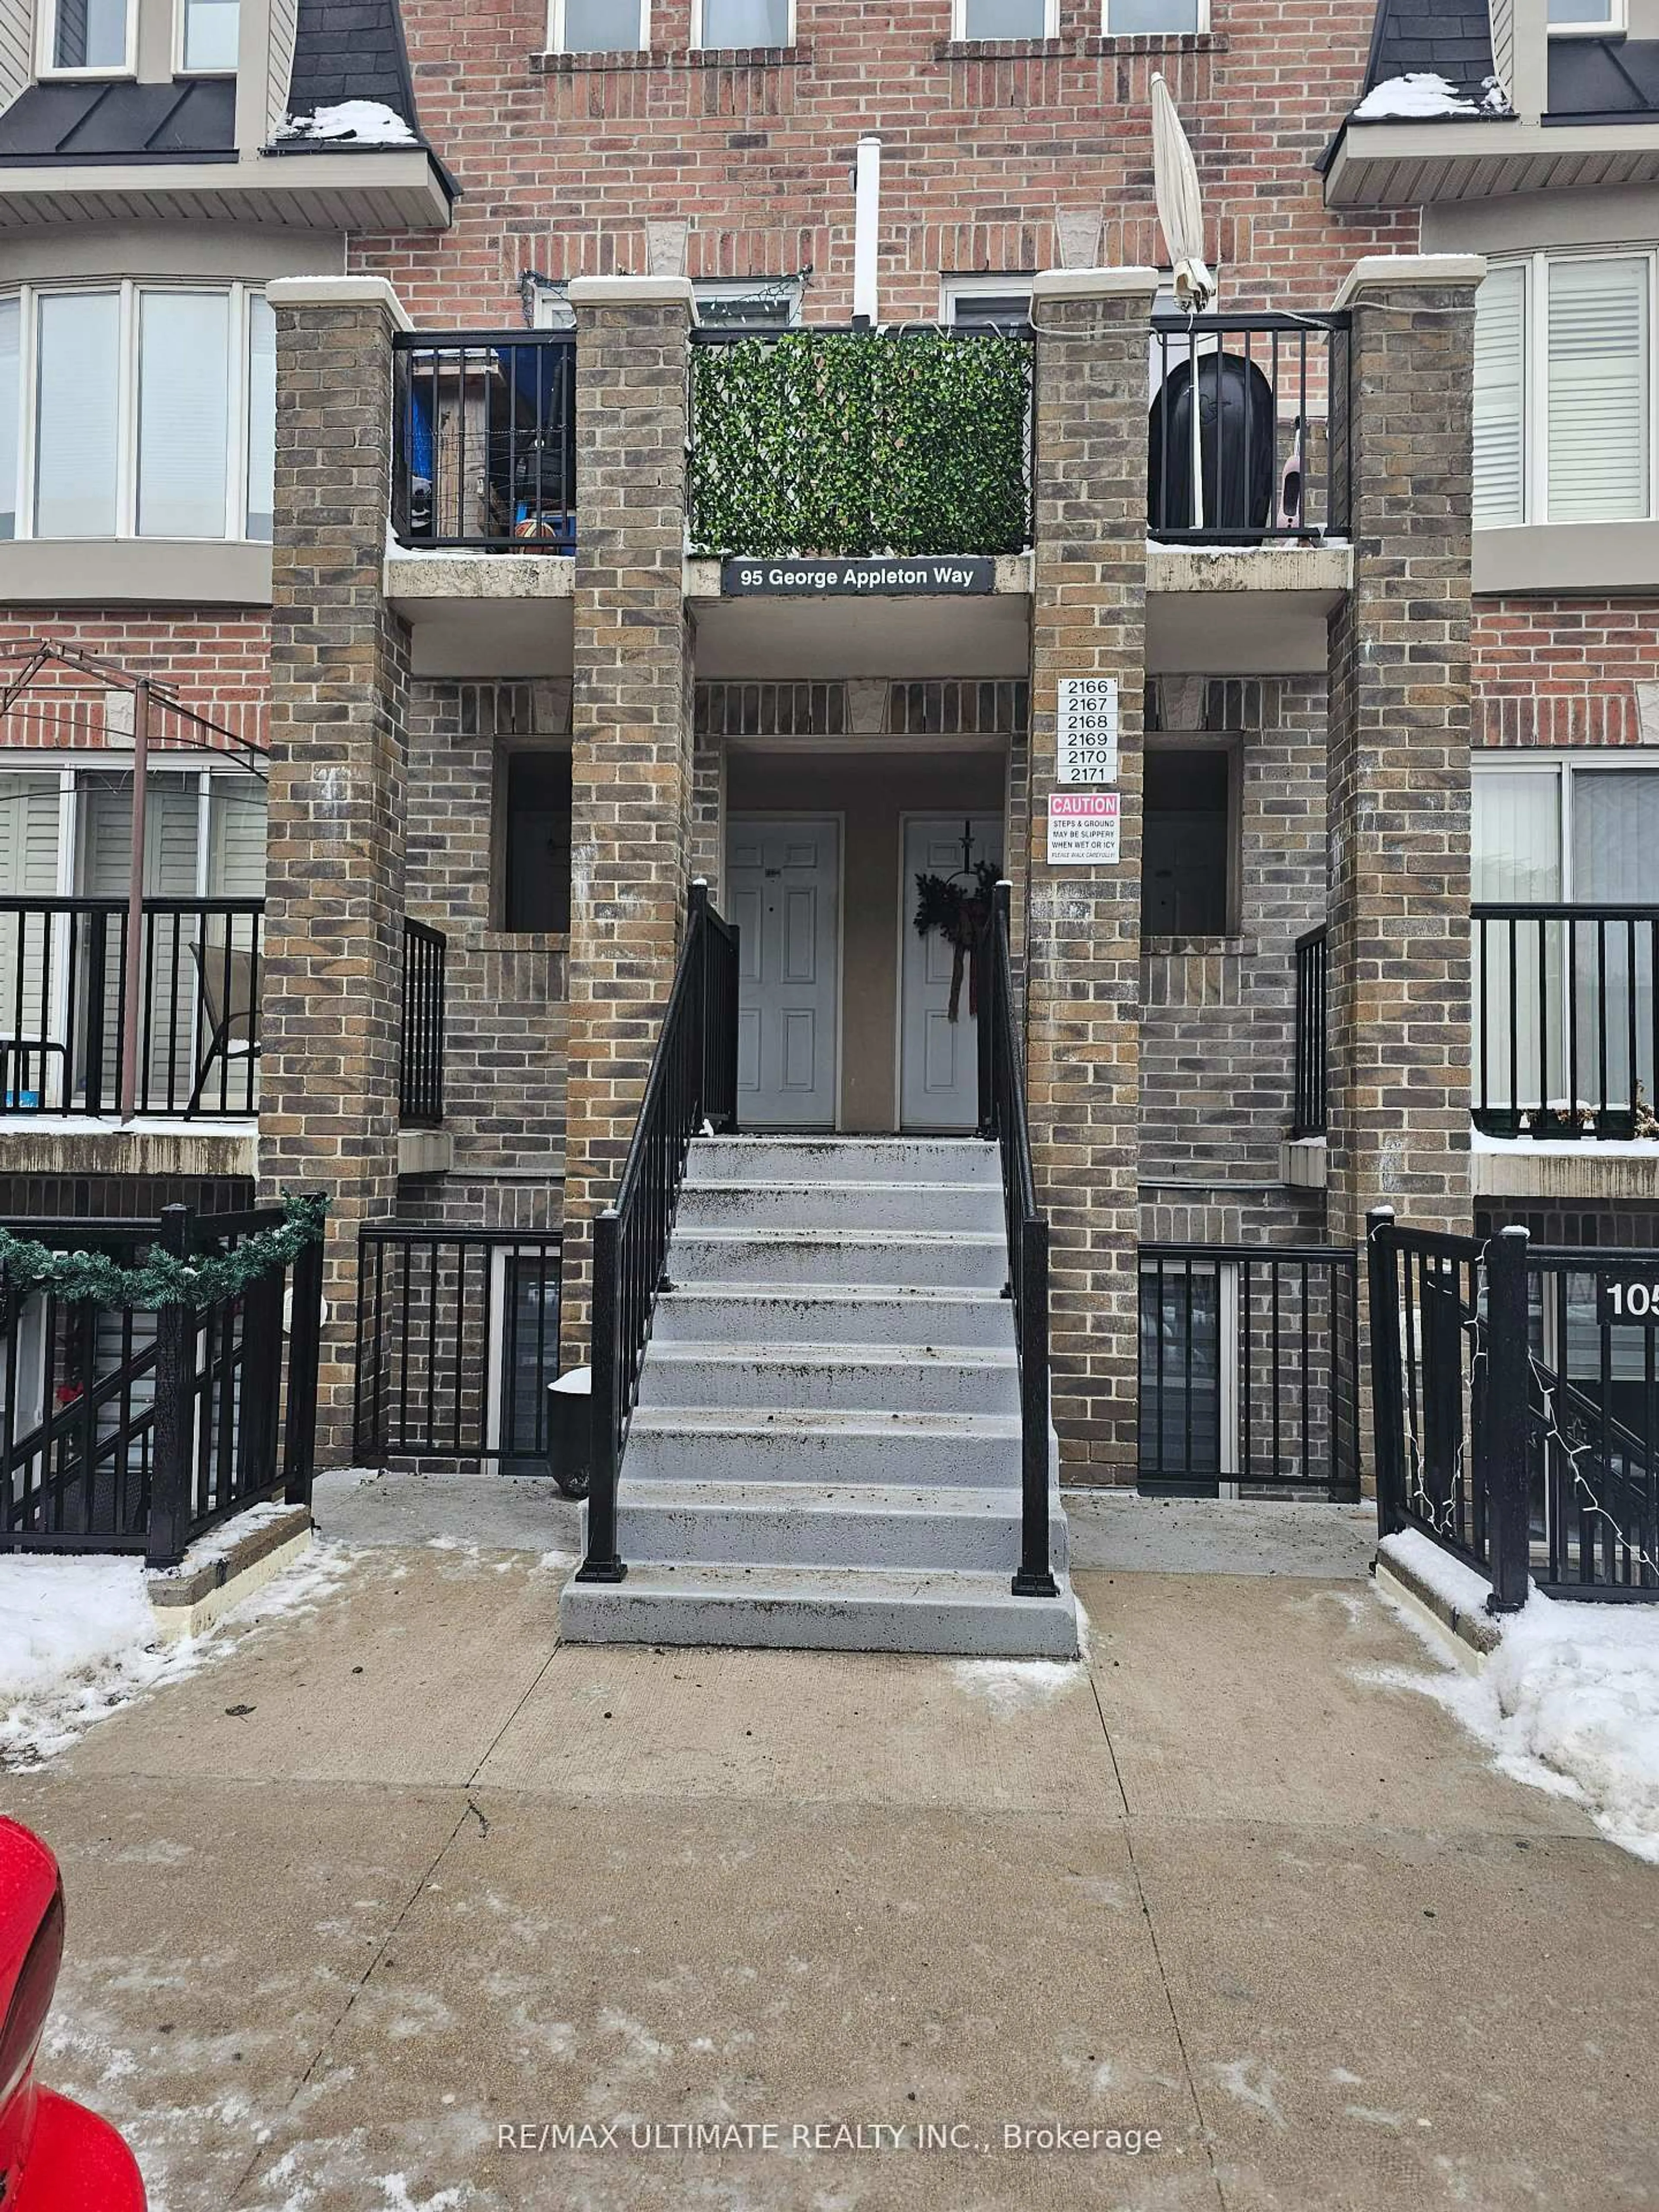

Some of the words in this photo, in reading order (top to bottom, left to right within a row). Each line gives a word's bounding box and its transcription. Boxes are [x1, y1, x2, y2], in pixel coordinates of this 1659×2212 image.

[741, 570, 763, 585] 95
[769, 569, 838, 588] George
[843, 568, 927, 588] Appleton
[933, 567, 974, 587] Way
[1068, 680, 1108, 693] 2166
[1069, 698, 1107, 711] 2167
[1068, 715, 1107, 728] 2168
[1068, 733, 1107, 746] 2169
[1069, 750, 1106, 763] 2170
[1071, 768, 1104, 781] 2171
[1052, 797, 1115, 813] CAUTION
